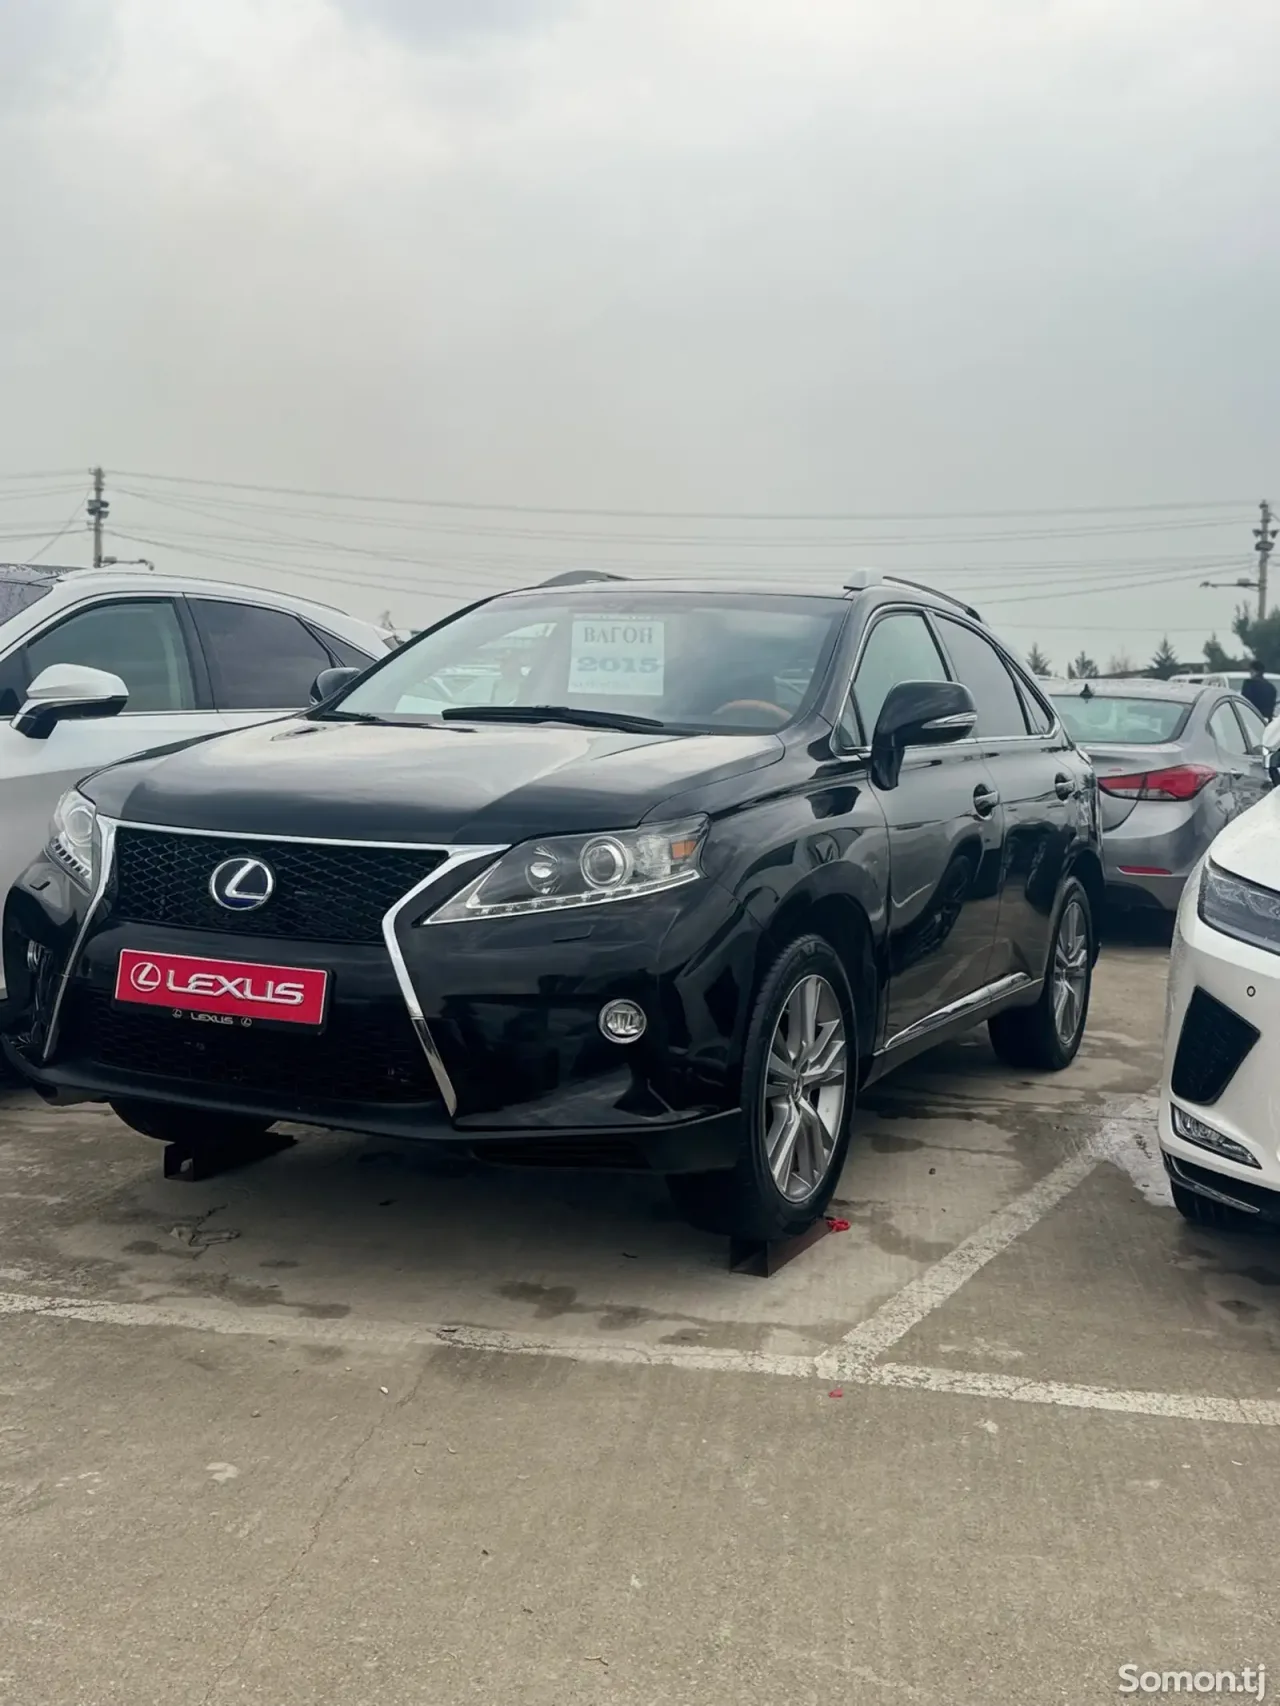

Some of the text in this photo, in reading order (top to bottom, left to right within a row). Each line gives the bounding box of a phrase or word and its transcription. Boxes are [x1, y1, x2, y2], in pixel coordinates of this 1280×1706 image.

[577, 656, 661, 674] 2015
[166, 969, 304, 1005] LEXUS
[190, 1012, 234, 1025] LEXUS
